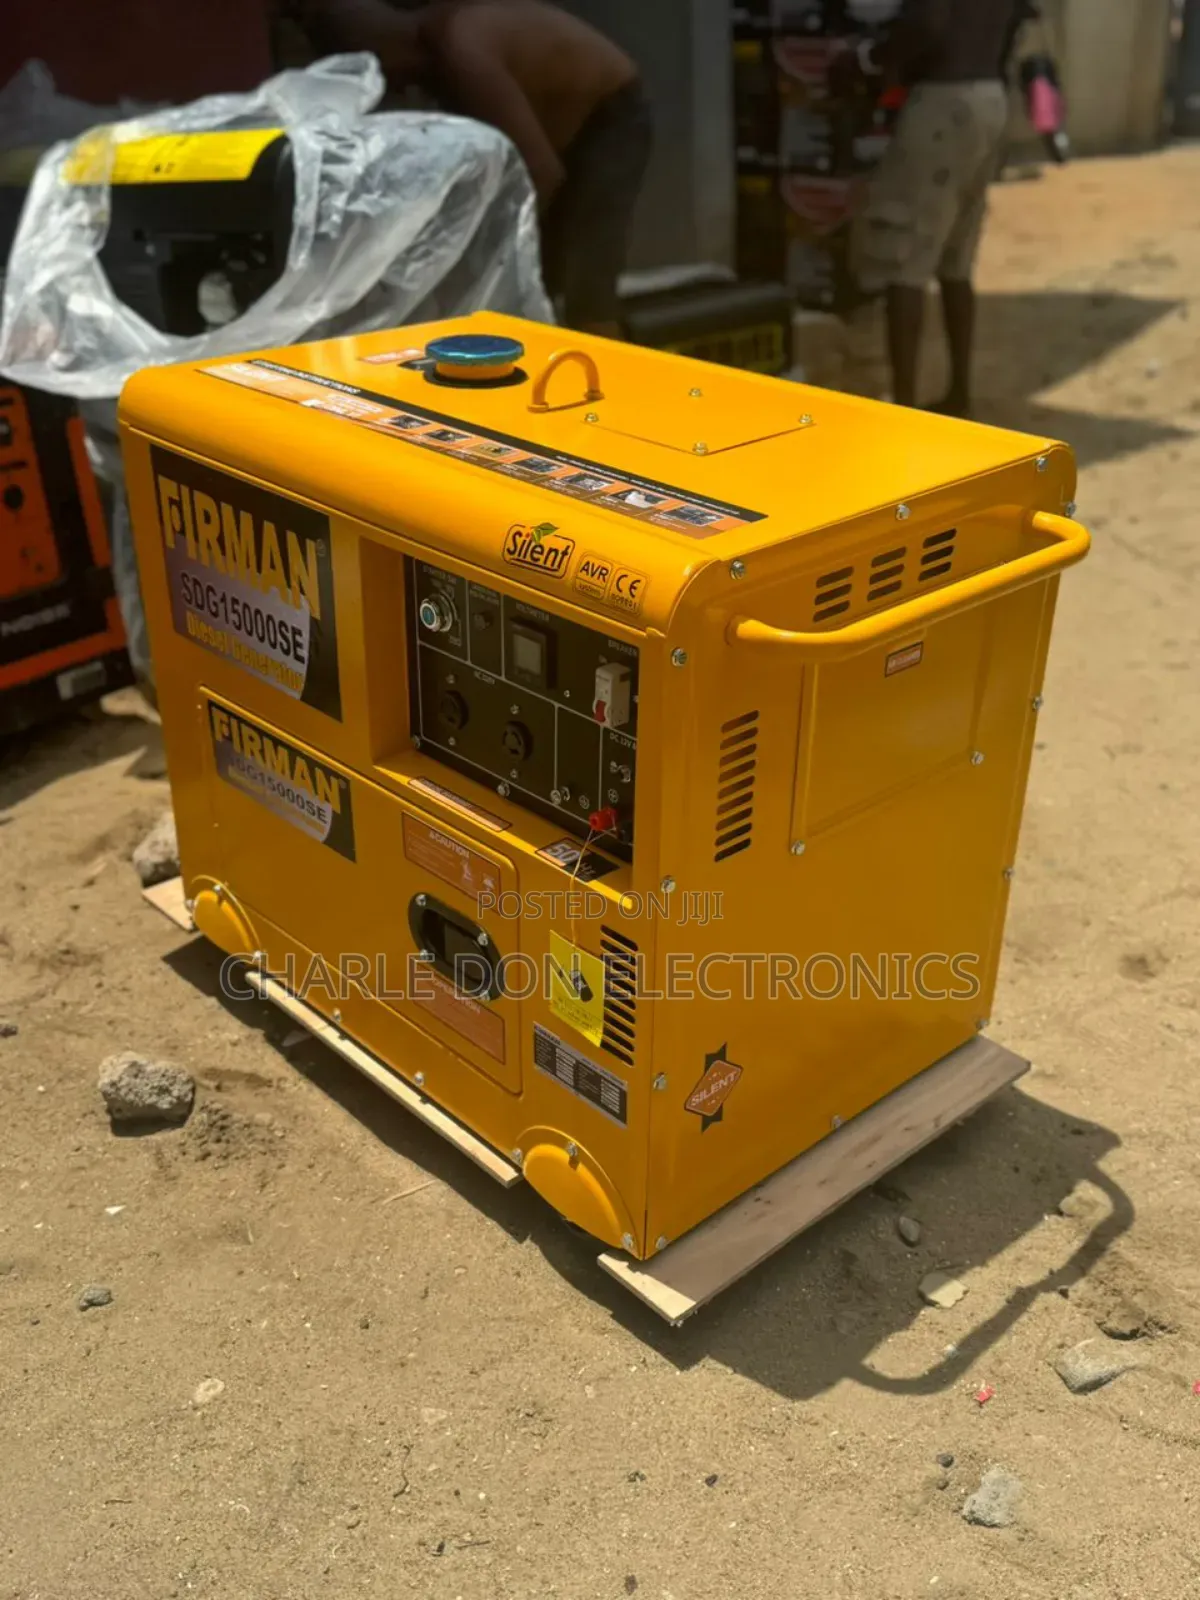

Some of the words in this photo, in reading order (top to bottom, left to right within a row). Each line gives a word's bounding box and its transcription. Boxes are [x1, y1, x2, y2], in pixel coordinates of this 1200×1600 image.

[157, 474, 321, 621] FIRMAN
[506, 530, 571, 570] Silent
[580, 560, 609, 583] AVR
[616, 574, 642, 598] CE
[180, 572, 306, 666] SDG15000SE
[211, 706, 341, 815] FIRMAN
[546, 842, 582, 864] 50
[690, 1071, 738, 1106] SILENT
